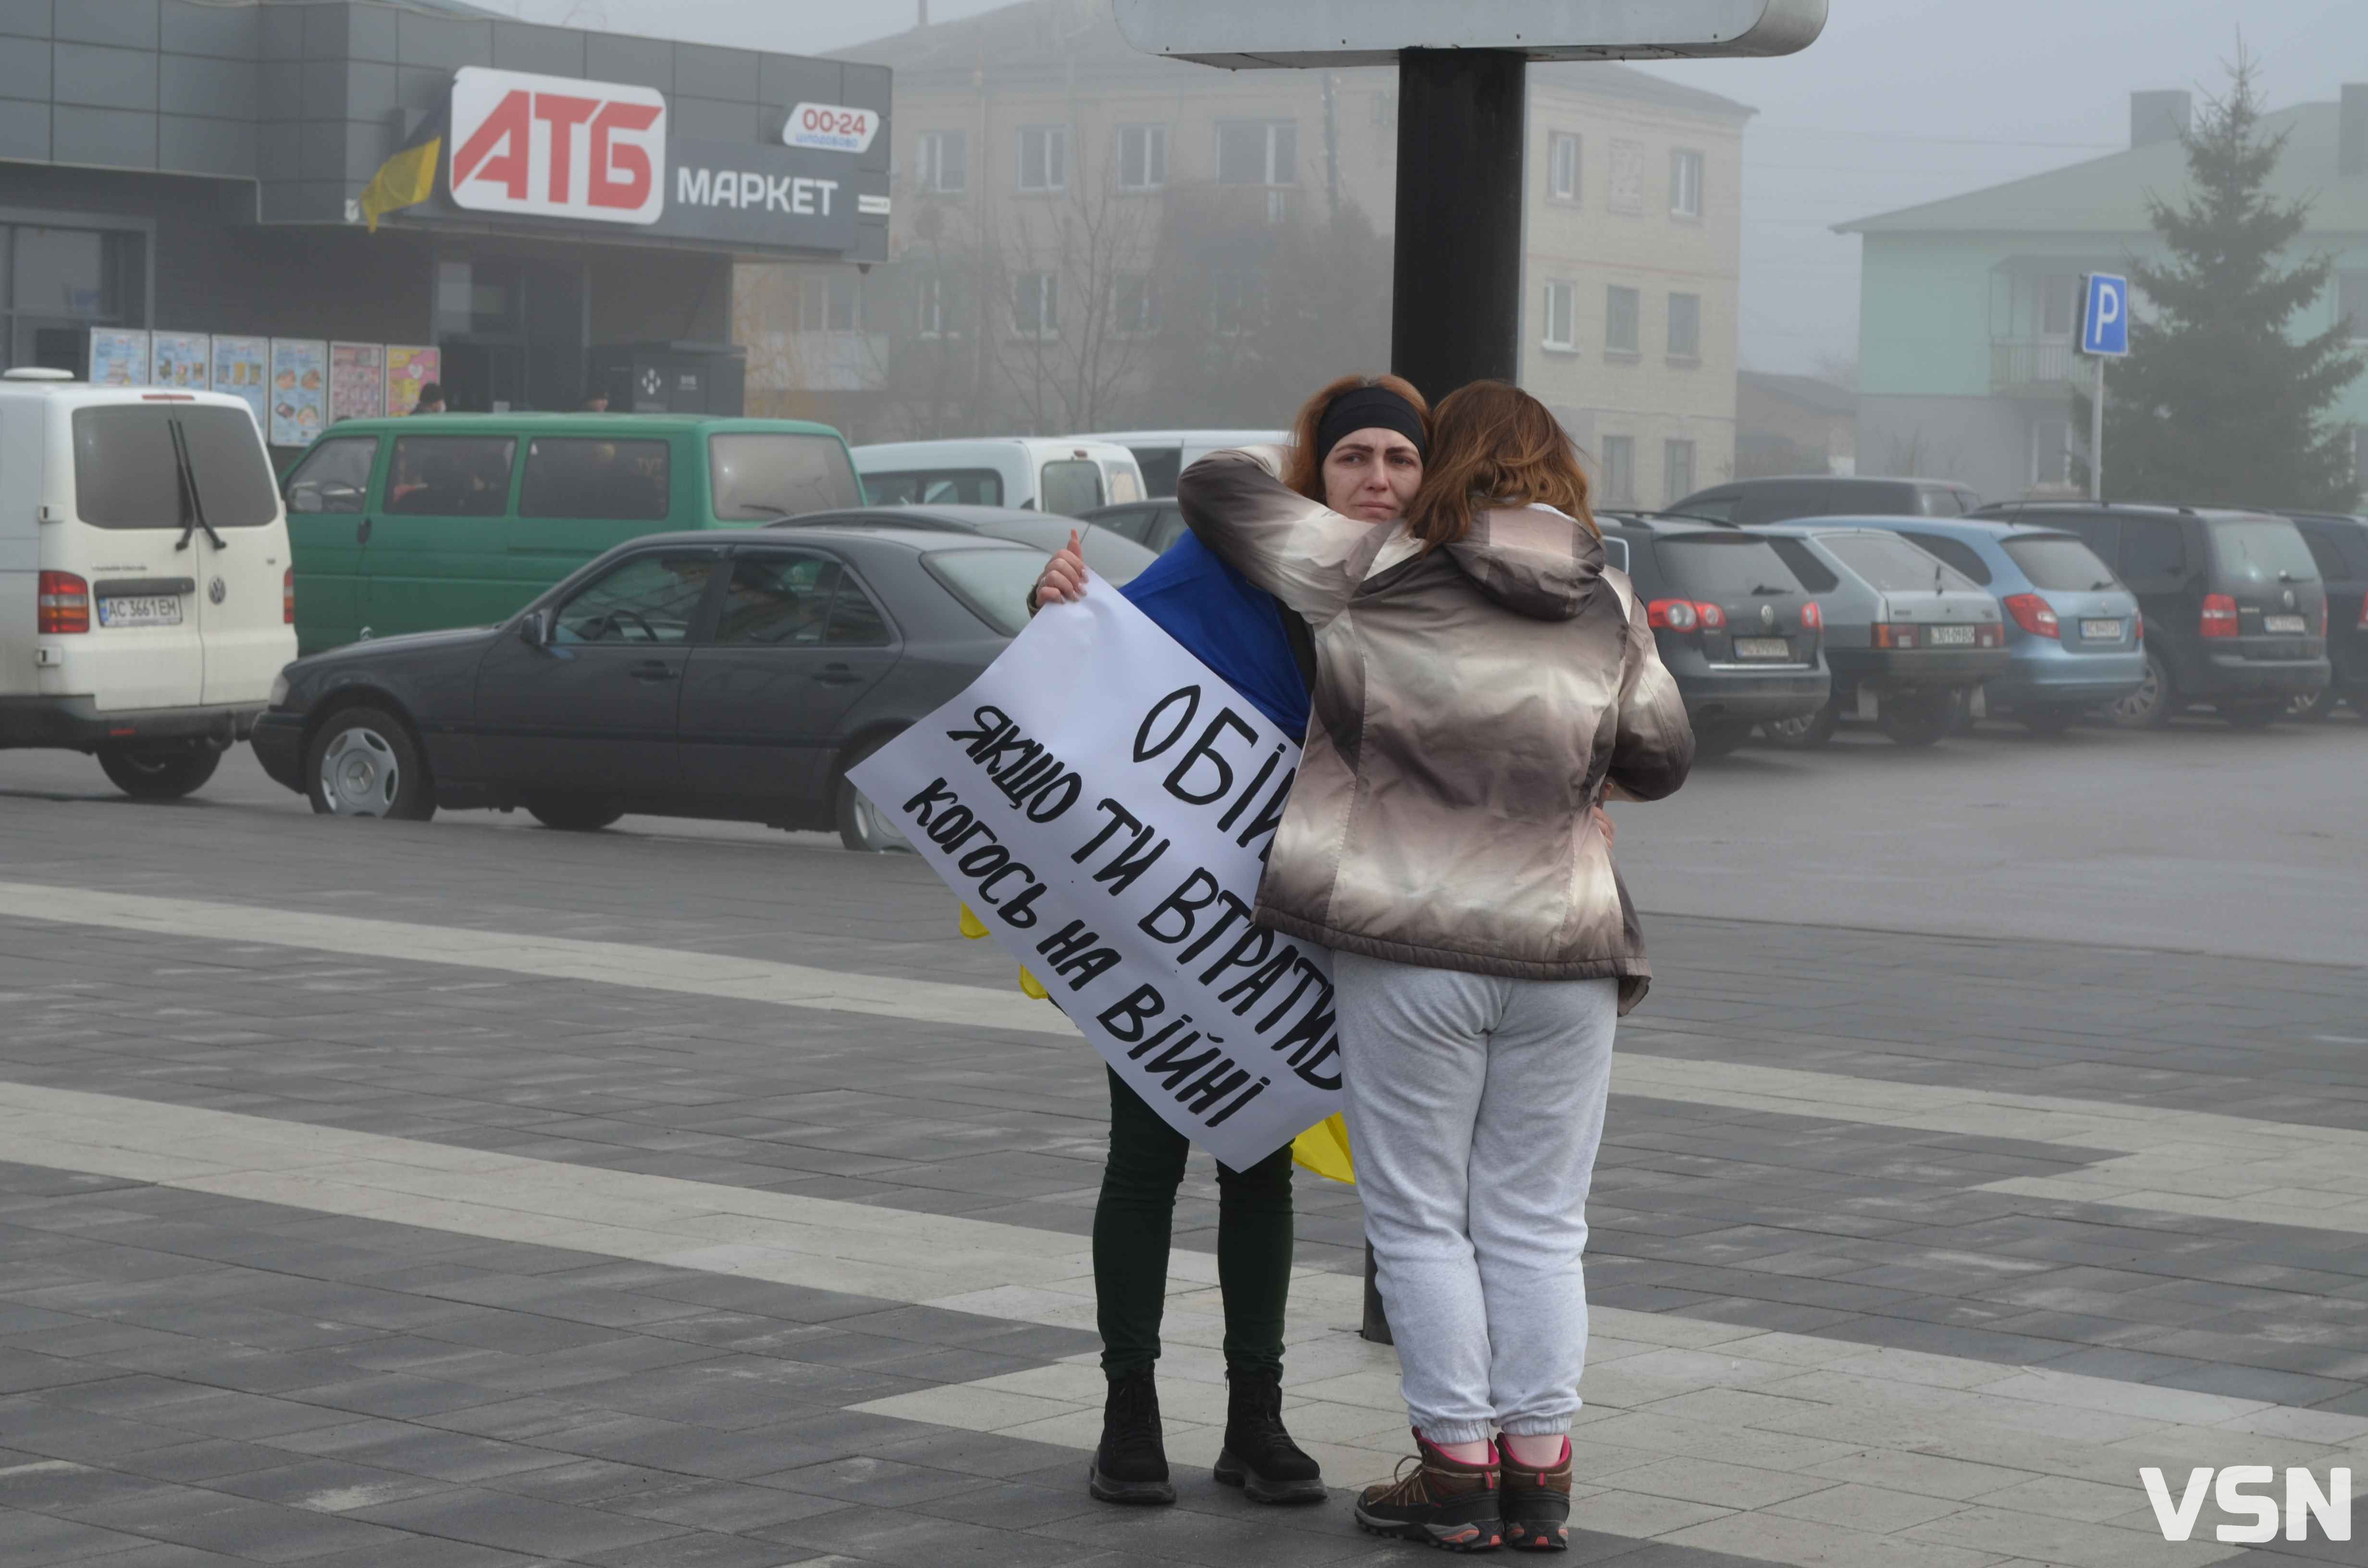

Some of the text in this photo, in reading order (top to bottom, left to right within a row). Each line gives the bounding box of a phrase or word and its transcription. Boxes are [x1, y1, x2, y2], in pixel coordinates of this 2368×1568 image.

[453, 90, 663, 210] АТБ
[803, 109, 866, 136] 00-24
[678, 167, 838, 216] МАРКЕТ
[2095, 283, 2119, 344] P
[946, 705, 1082, 823] ЯКЩО
[1071, 797, 1170, 896] ТИ
[902, 777, 1271, 1128] КОГОСЬ НА ВІЙНІ
